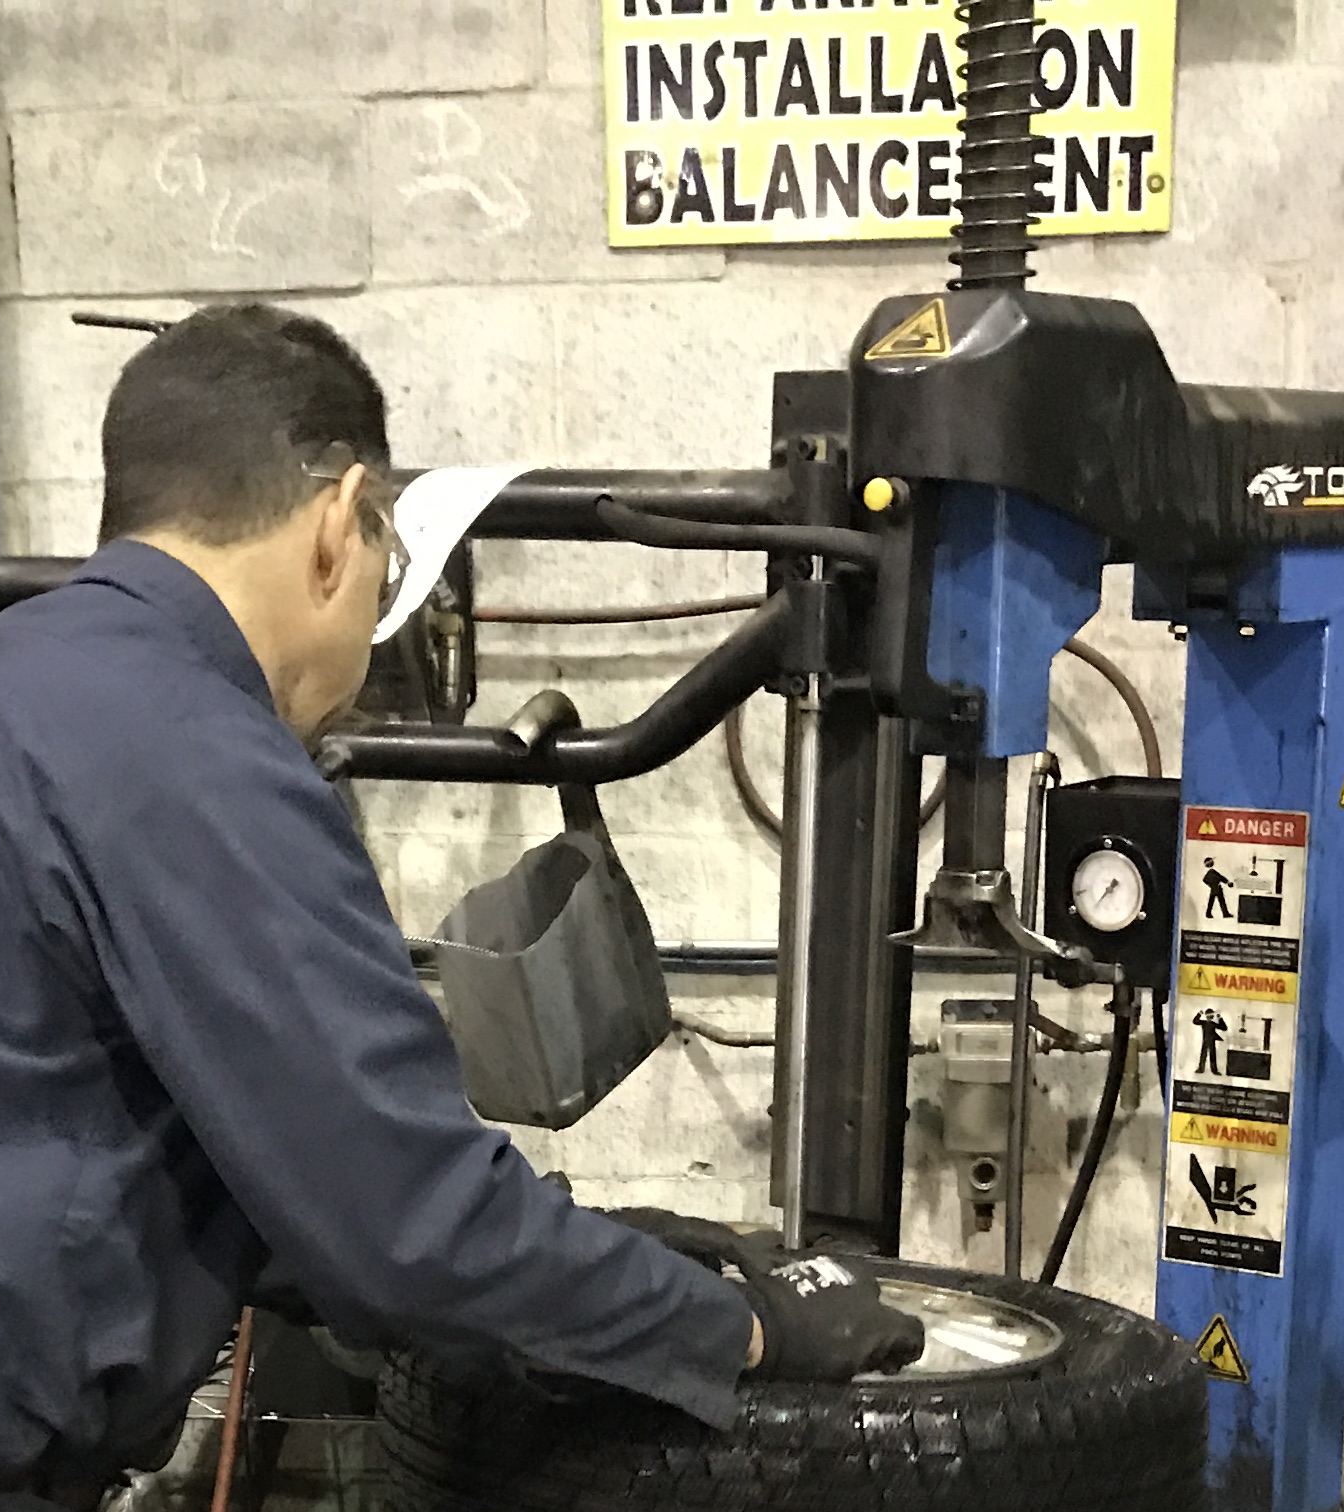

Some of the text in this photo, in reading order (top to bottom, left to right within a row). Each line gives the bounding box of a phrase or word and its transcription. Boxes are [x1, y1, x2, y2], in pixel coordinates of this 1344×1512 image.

[625, 29, 1133, 122] INSTALLAON
[624, 135, 1154, 225] BALANCEENT
[1224, 817, 1295, 838] DANGER
[1214, 972, 1286, 994] WARNING
[1205, 1123, 1277, 1147] WARNING
